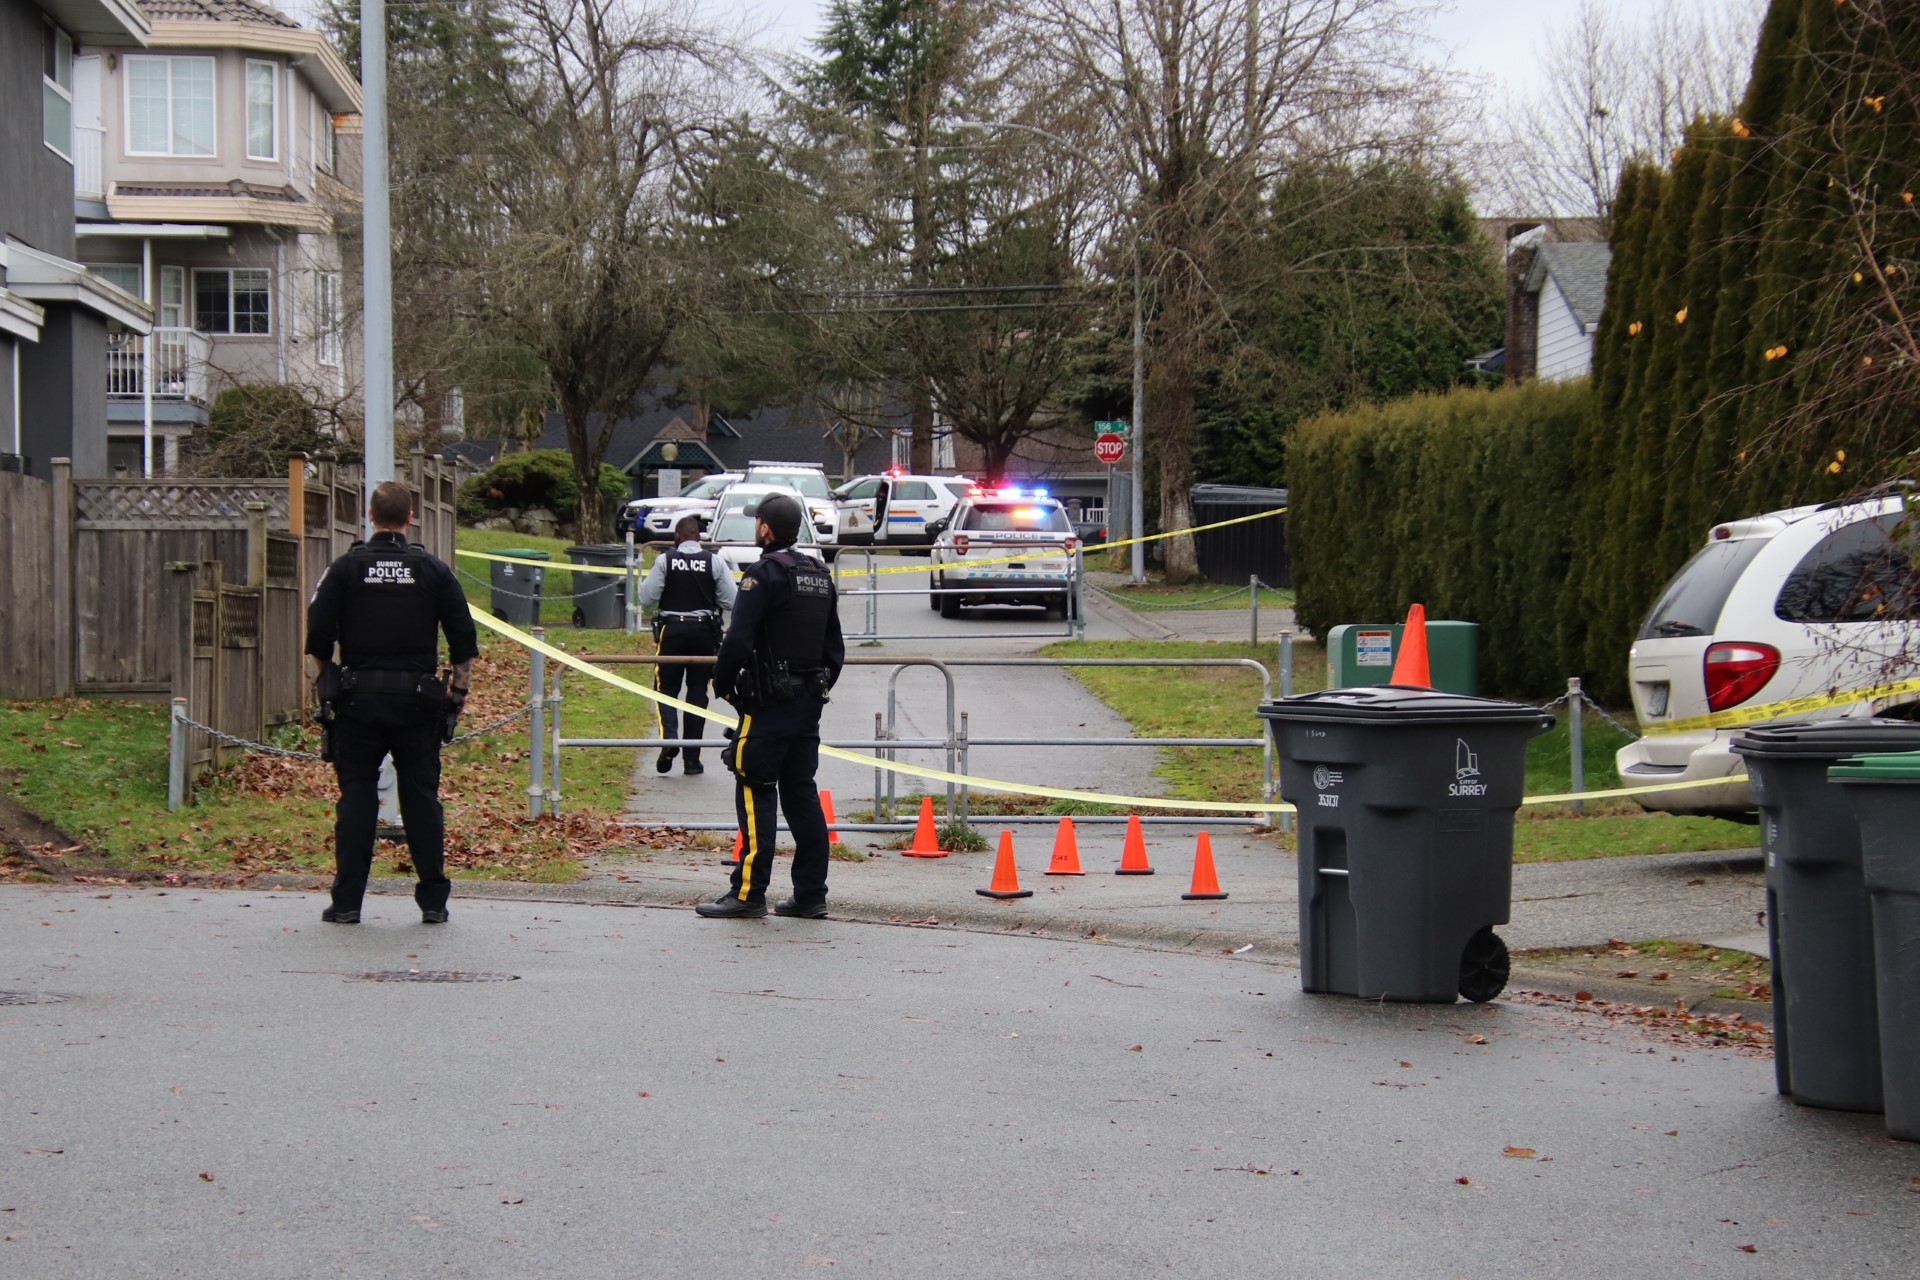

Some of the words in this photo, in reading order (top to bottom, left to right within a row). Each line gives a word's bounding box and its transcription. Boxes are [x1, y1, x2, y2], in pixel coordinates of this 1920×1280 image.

[1097, 422, 1111, 430] 156
[1097, 441, 1122, 455] STOP
[995, 532, 1039, 540] POLICE
[376, 560, 403, 568] SURREY
[671, 558, 706, 572] POLICE
[368, 567, 411, 578] POLICE
[796, 575, 829, 589] POLICE
[1448, 783, 1488, 796] SURREY
[1318, 793, 1339, 808] 353737
